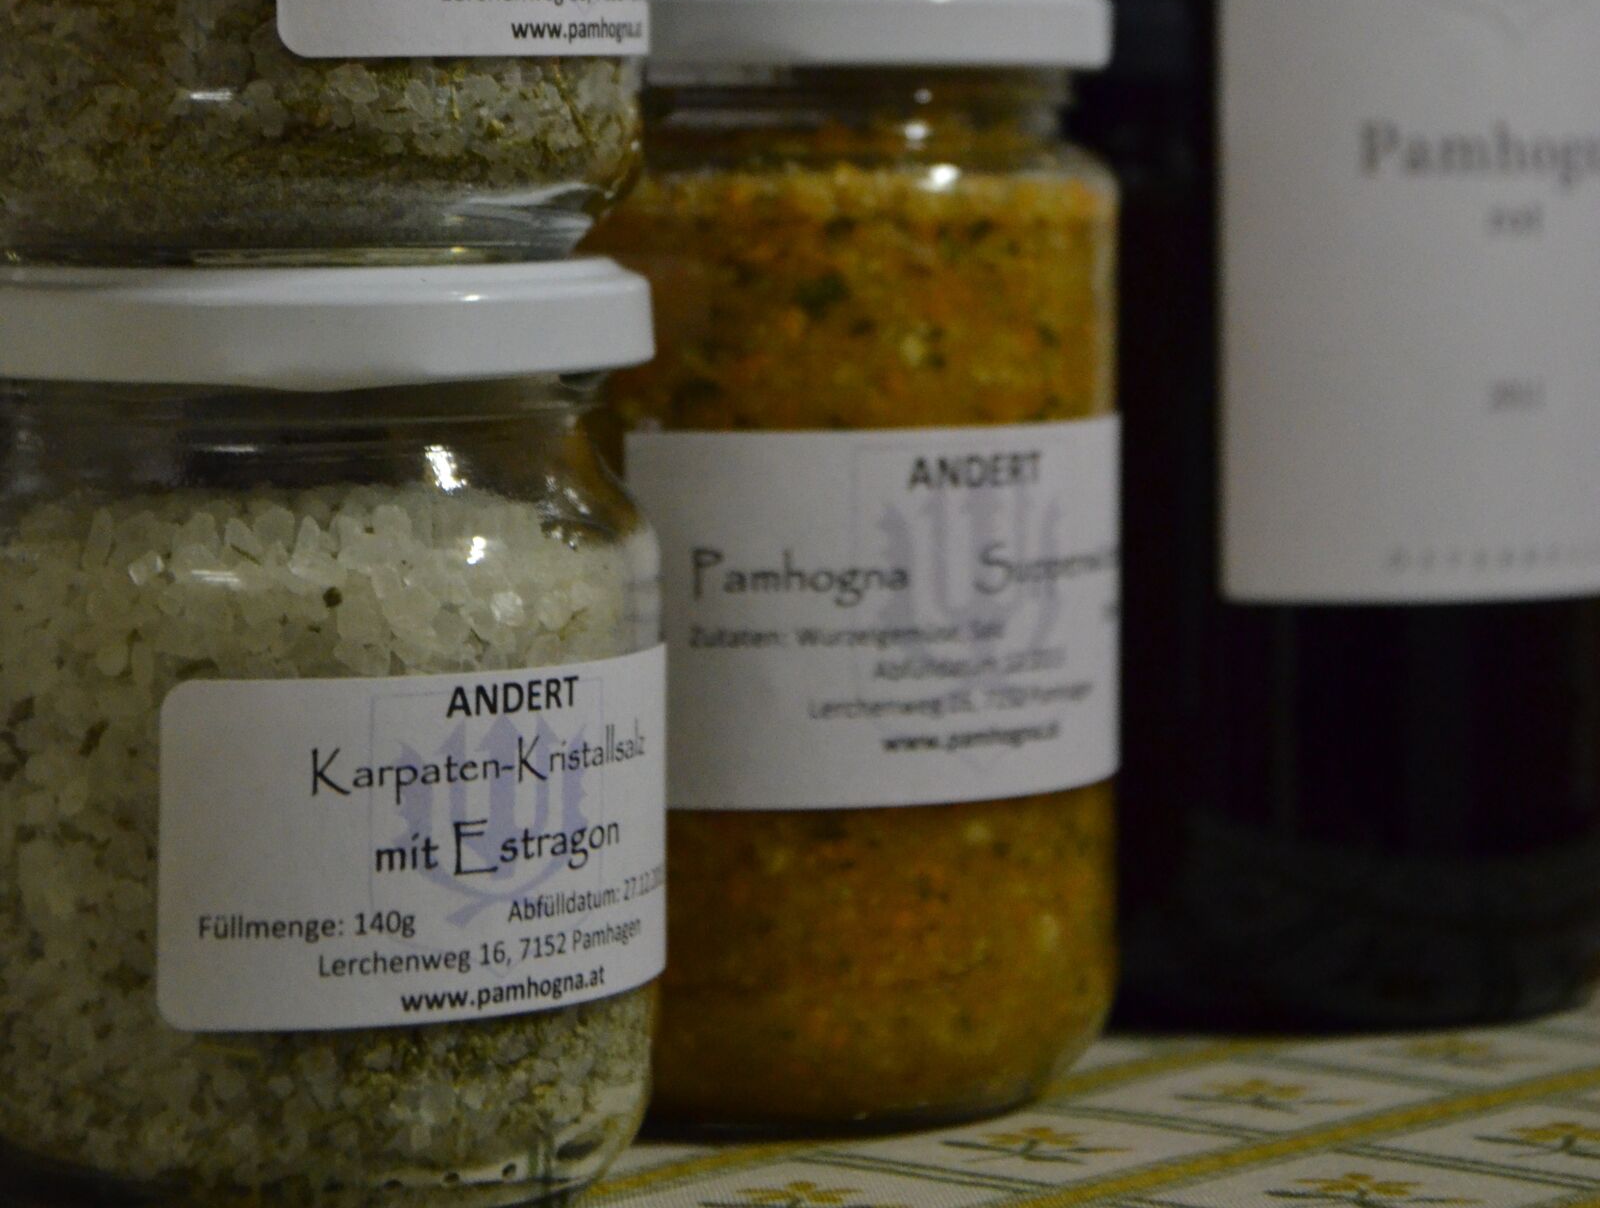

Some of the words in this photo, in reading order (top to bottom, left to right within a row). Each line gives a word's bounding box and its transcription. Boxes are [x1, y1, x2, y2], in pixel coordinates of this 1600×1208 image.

[907, 449, 1042, 491] ANDERT
[691, 546, 910, 609] Pamhogna
[446, 676, 580, 719] ANDERT
[310, 716, 647, 805] Karpaten-Kristallsalz
[375, 831, 439, 874] mit
[452, 818, 621, 876] Estragon
[197, 912, 345, 944] Füllmenge:
[353, 909, 417, 943] 140g
[507, 886, 621, 923] Abfülldatum:
[318, 946, 472, 979] Lerchenweg
[480, 941, 513, 968] 16,
[519, 931, 567, 962] 7152
[572, 918, 643, 953] Pamhagen
[401, 965, 607, 1014] www.pamhogna.at
